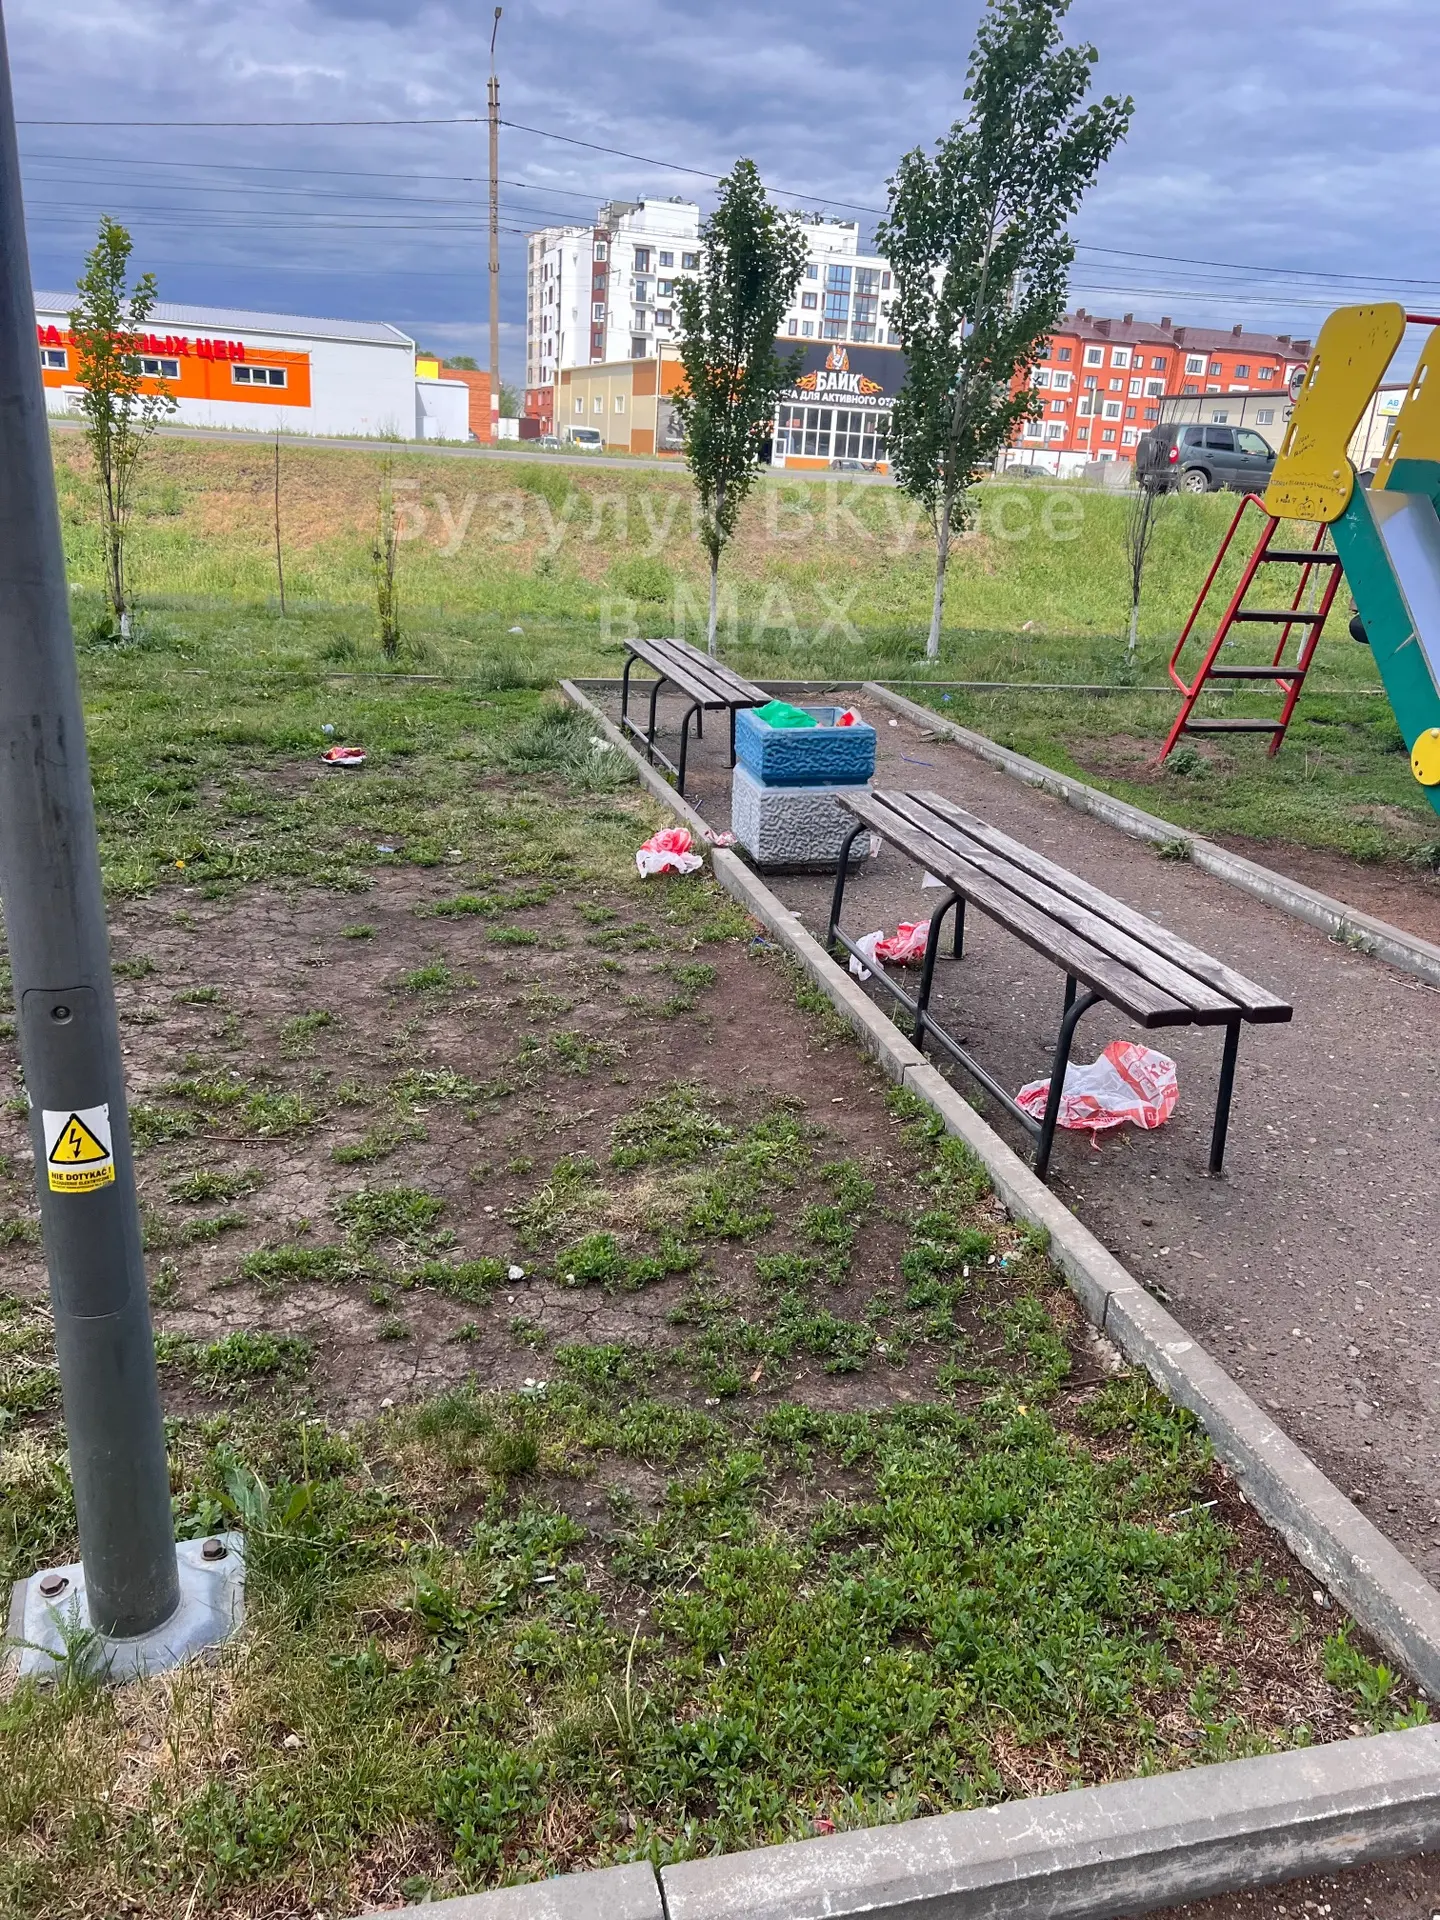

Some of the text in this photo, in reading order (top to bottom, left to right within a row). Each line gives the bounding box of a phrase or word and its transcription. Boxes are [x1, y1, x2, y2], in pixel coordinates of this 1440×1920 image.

[196, 338, 245, 361] ЦЕН
[816, 371, 861, 394] БАЙК
[800, 391, 820, 401] ДЛЯ
[822, 392, 876, 405] АКТИВНОГО
[51, 1171, 64, 1180] NIE
